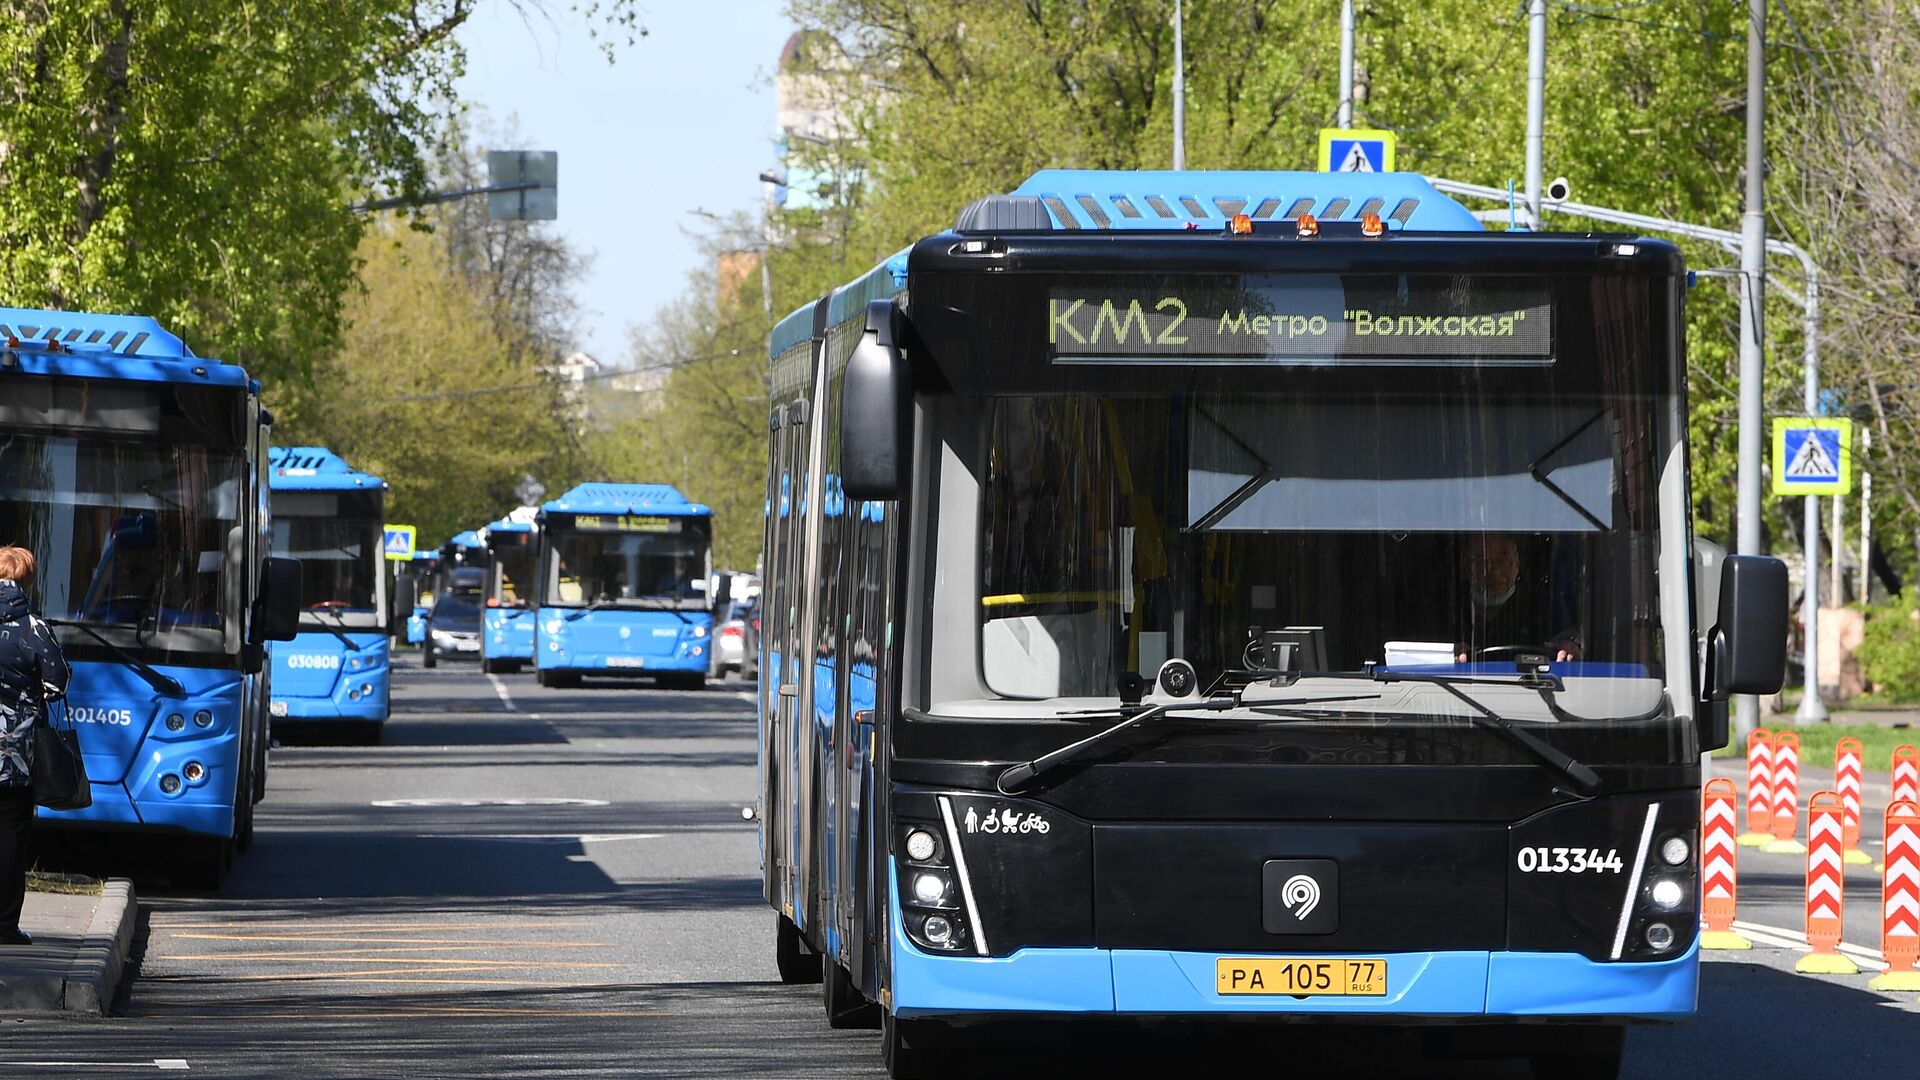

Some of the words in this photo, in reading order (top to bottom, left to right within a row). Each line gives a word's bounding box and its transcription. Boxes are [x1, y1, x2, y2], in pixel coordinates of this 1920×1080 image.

[1049, 297, 1188, 345] КМ2
[1217, 309, 1328, 338] Метро
[1343, 309, 1526, 336] "Волжская"
[63, 706, 132, 726] 201405
[1517, 846, 1624, 874] 013344
[1280, 963, 1331, 990] 105
[1348, 962, 1375, 983] 77
[1352, 983, 1373, 992] RUS
